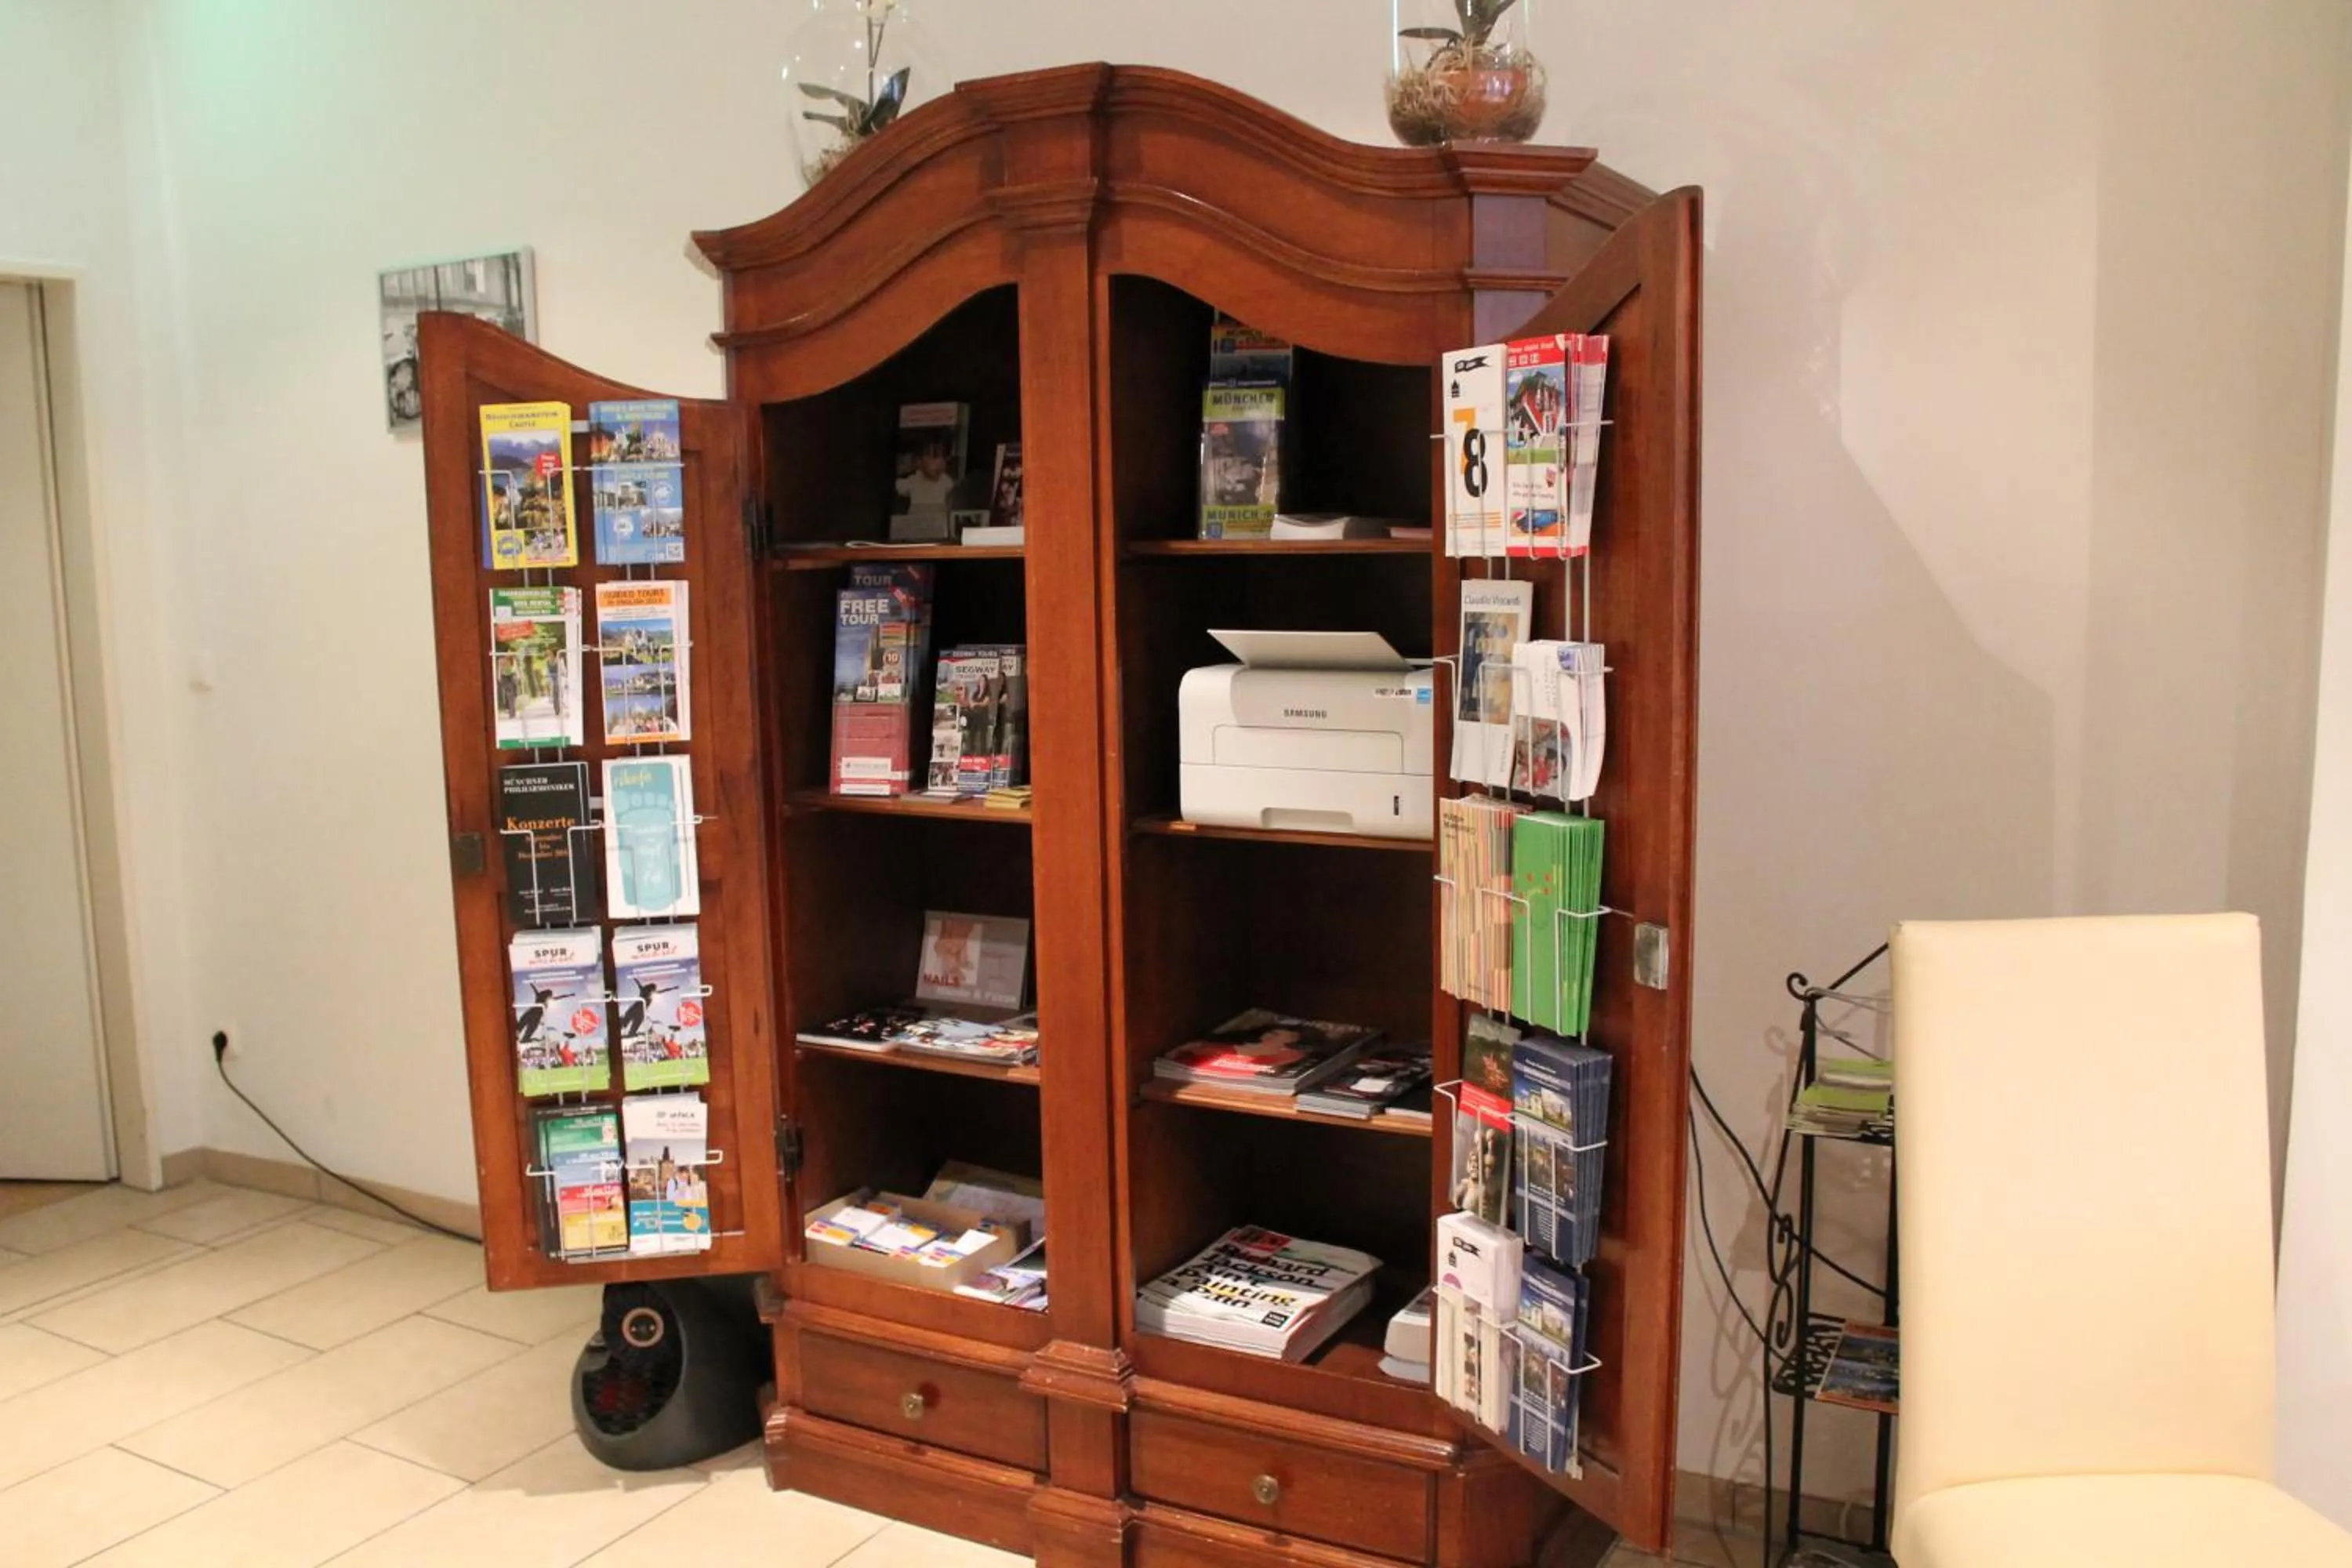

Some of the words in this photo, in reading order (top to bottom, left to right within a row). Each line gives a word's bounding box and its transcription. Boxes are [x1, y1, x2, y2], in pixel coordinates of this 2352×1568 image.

[853, 575, 891, 586] TOUR
[840, 598, 890, 614] FREE
[840, 614, 878, 625] TOUR
[1283, 709, 1327, 719] SAMSUNG
[506, 816, 575, 829] Konzerte
[637, 942, 669, 952] SPUR
[535, 948, 567, 958] SPUR
